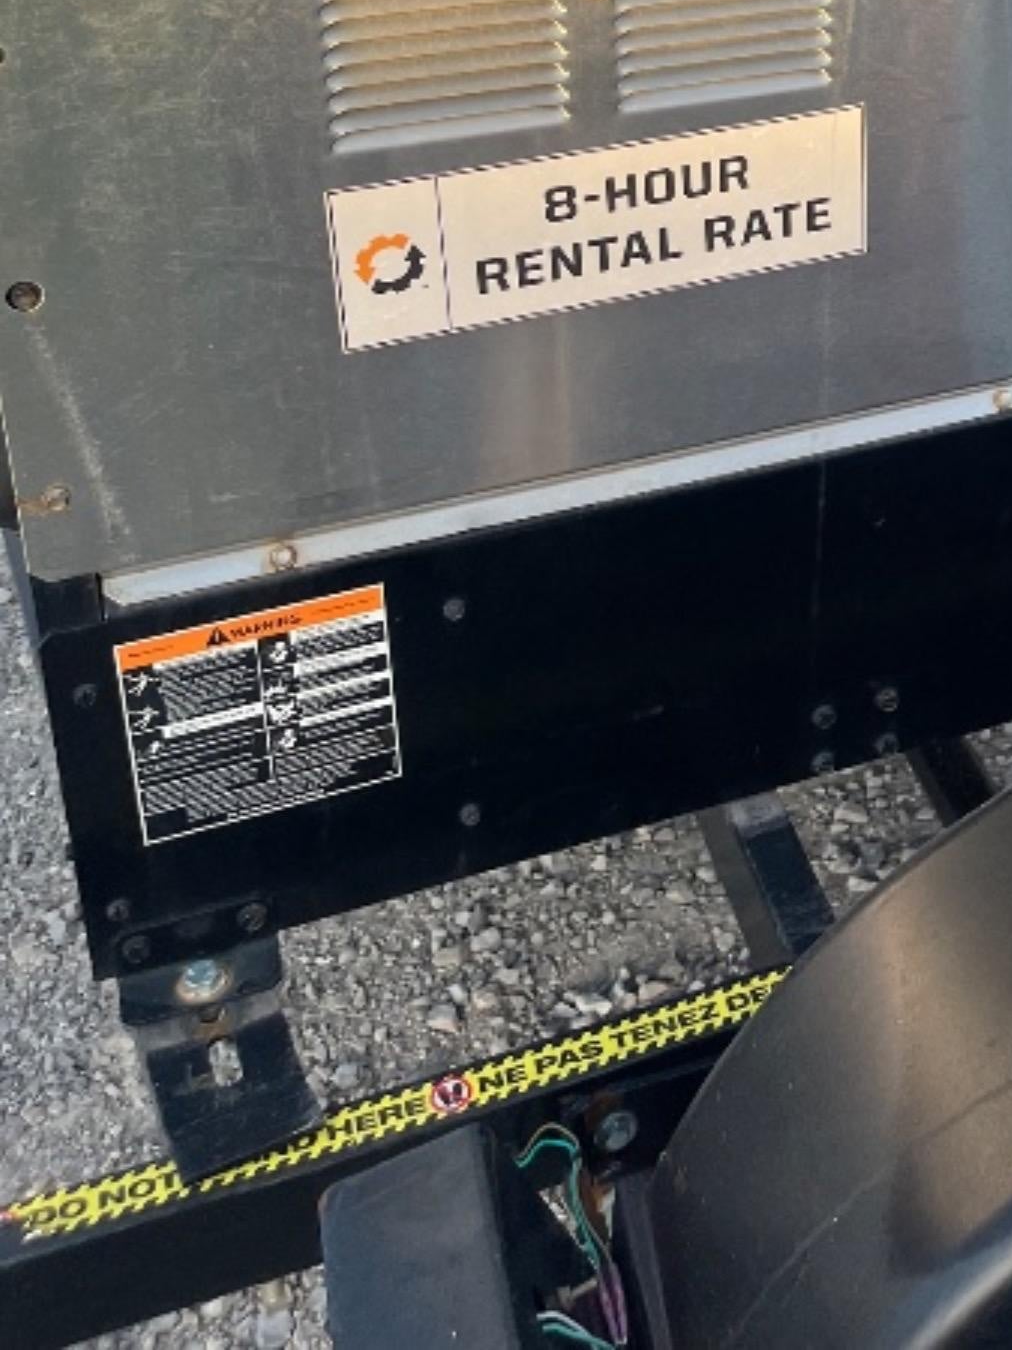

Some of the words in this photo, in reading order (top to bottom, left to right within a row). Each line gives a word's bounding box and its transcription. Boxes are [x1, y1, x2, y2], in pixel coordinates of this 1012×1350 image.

[544, 154, 750, 223] 8-HOUR
[475, 226, 684, 295] RENTAL
[703, 196, 832, 253] RATE
[30, 1197, 88, 1224] DO
[98, 1173, 178, 1209] NOT
[325, 1100, 425, 1140] HERE
[478, 1064, 529, 1093] NE
[536, 1039, 604, 1075] PAS
[609, 1001, 720, 1049] TENEZ
